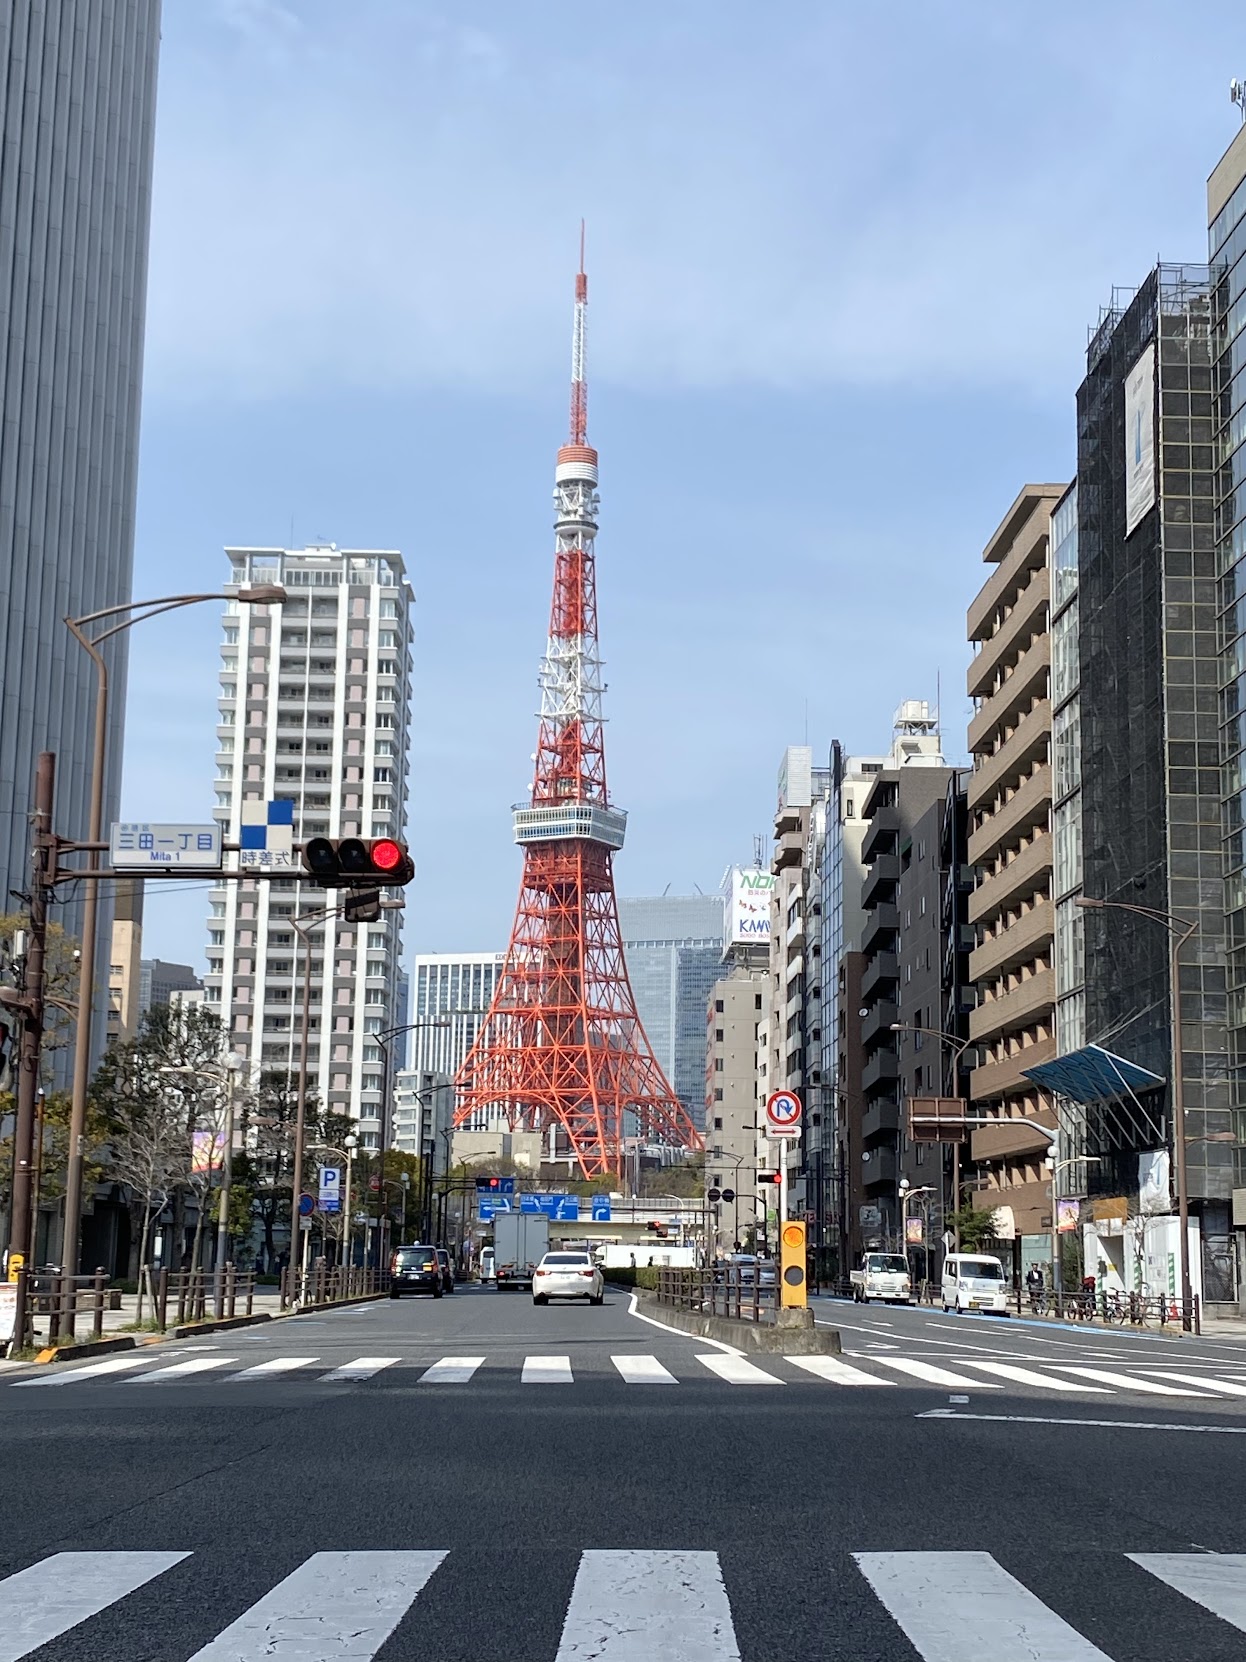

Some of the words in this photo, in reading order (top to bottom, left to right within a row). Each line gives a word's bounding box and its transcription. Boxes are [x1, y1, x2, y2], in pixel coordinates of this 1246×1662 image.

[118, 833, 212, 850] 三田一丁目
[150, 851, 172, 861] Mita
[175, 851, 181, 861] 1
[241, 851, 290, 866] 時差式
[323, 1170, 336, 1187] P
